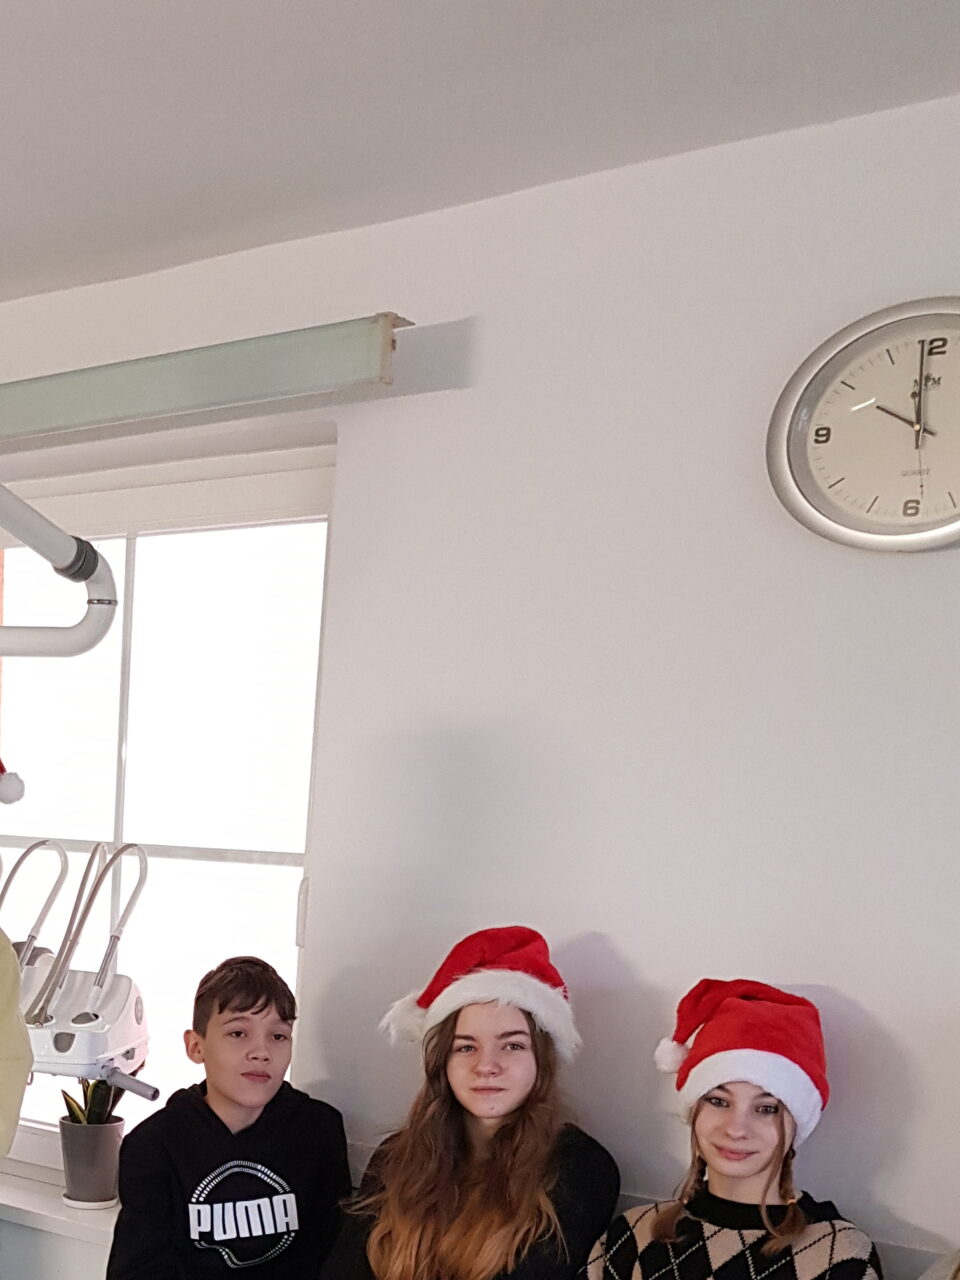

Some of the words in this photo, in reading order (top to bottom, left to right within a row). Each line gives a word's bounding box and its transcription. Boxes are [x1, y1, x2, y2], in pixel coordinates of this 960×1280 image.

[814, 427, 831, 444] 9
[903, 499, 921, 517] 6
[188, 1193, 299, 1241] PUMA
